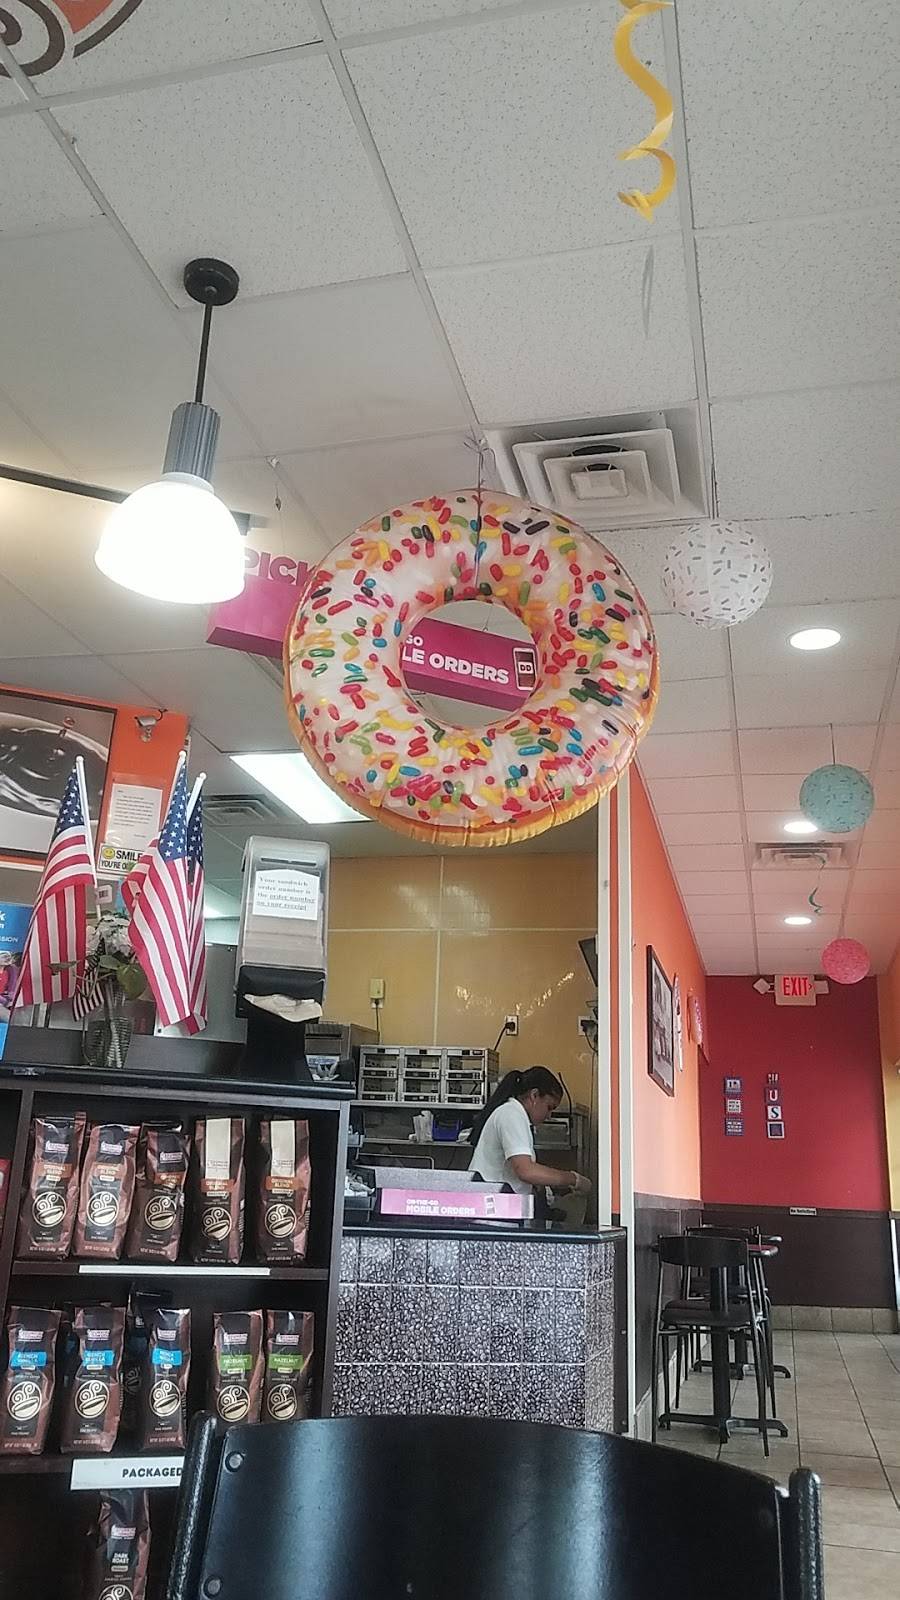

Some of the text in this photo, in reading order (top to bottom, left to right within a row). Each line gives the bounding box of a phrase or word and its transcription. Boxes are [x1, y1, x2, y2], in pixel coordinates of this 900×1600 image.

[429, 653, 509, 685] ORDERS
[519, 664, 532, 673] DD
[783, 977, 808, 996] EXIT
[770, 1107, 779, 1119] S
[406, 1205, 476, 1215] MOBILE ORDERS
[122, 1467, 183, 1478] PACKAGED
